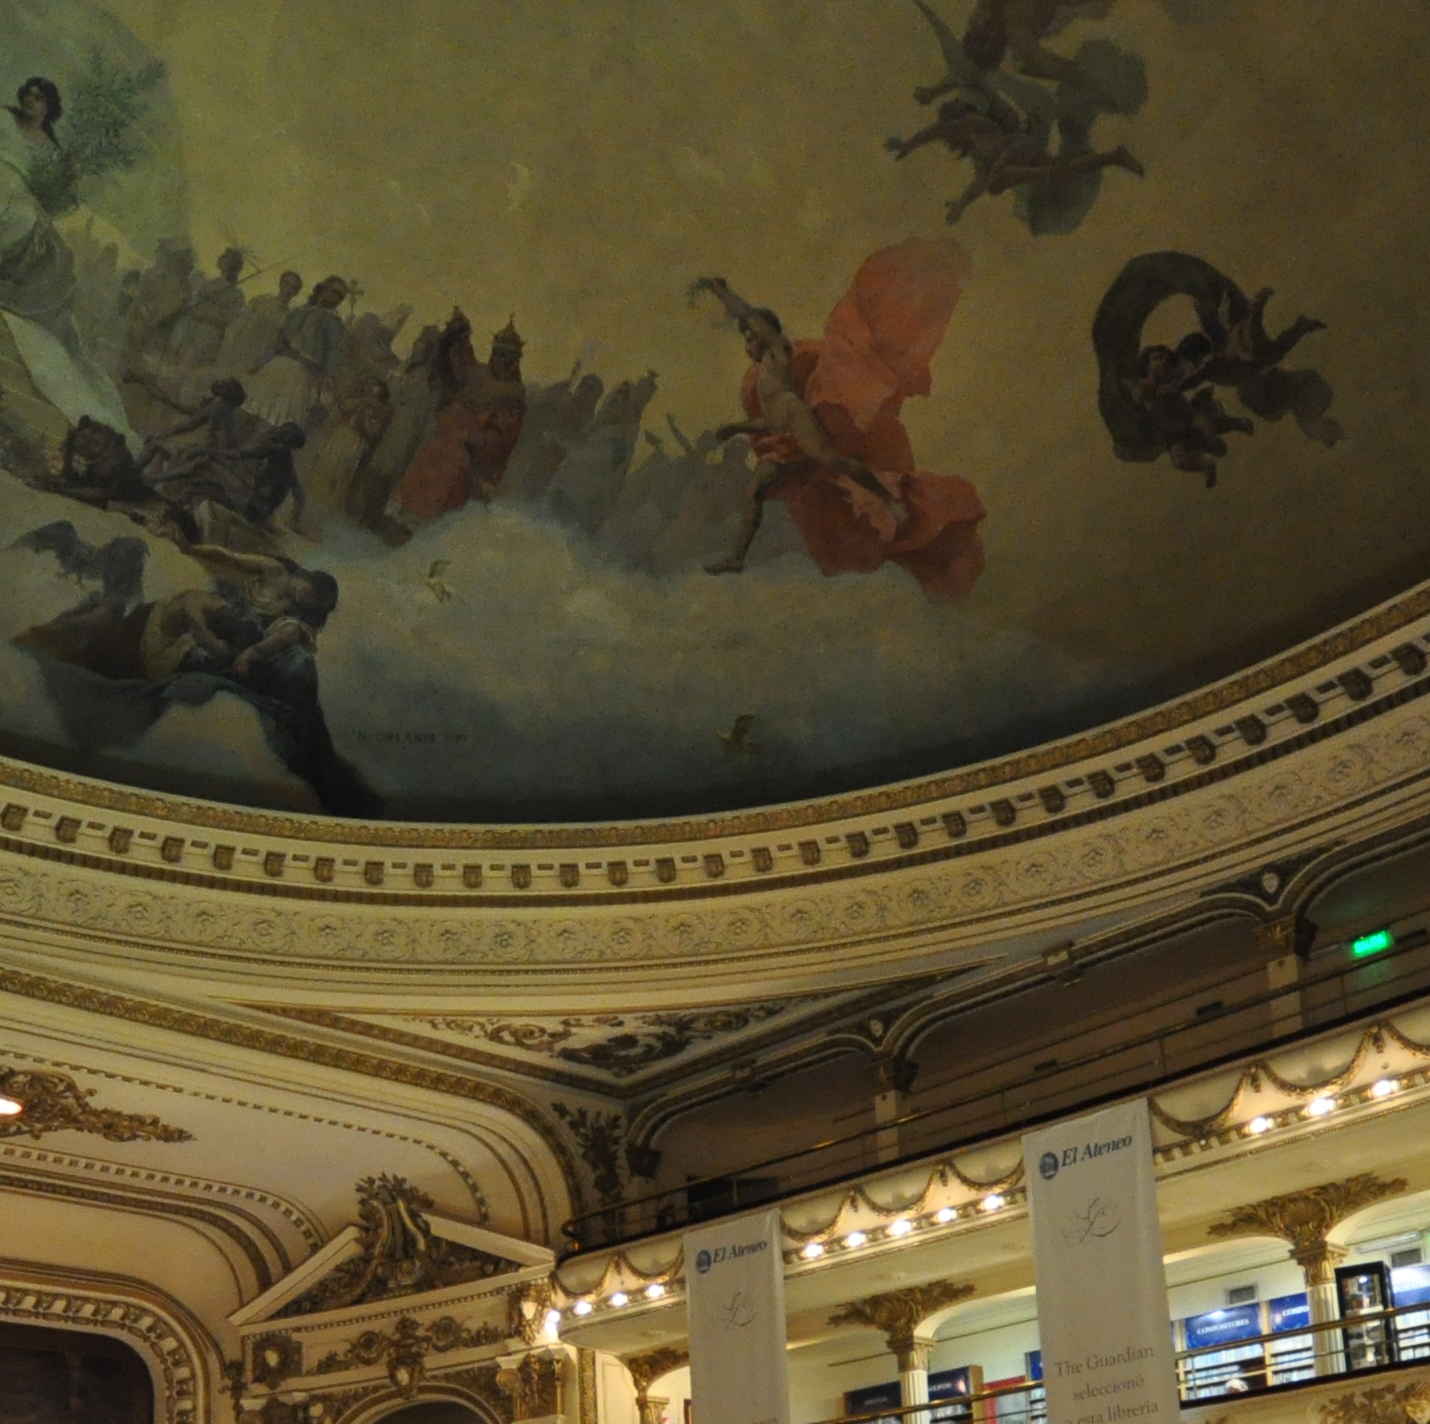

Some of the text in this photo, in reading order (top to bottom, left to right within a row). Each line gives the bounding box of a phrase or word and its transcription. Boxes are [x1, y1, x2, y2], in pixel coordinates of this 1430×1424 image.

[1061, 1135, 1132, 1167] El Ateneo
[713, 1240, 767, 1264] El Ateneo
[1197, 1318, 1250, 1335] COMPOSITORES
[1054, 1346, 1154, 1377] The Guardian
[1073, 1374, 1145, 1401] seleccionó
